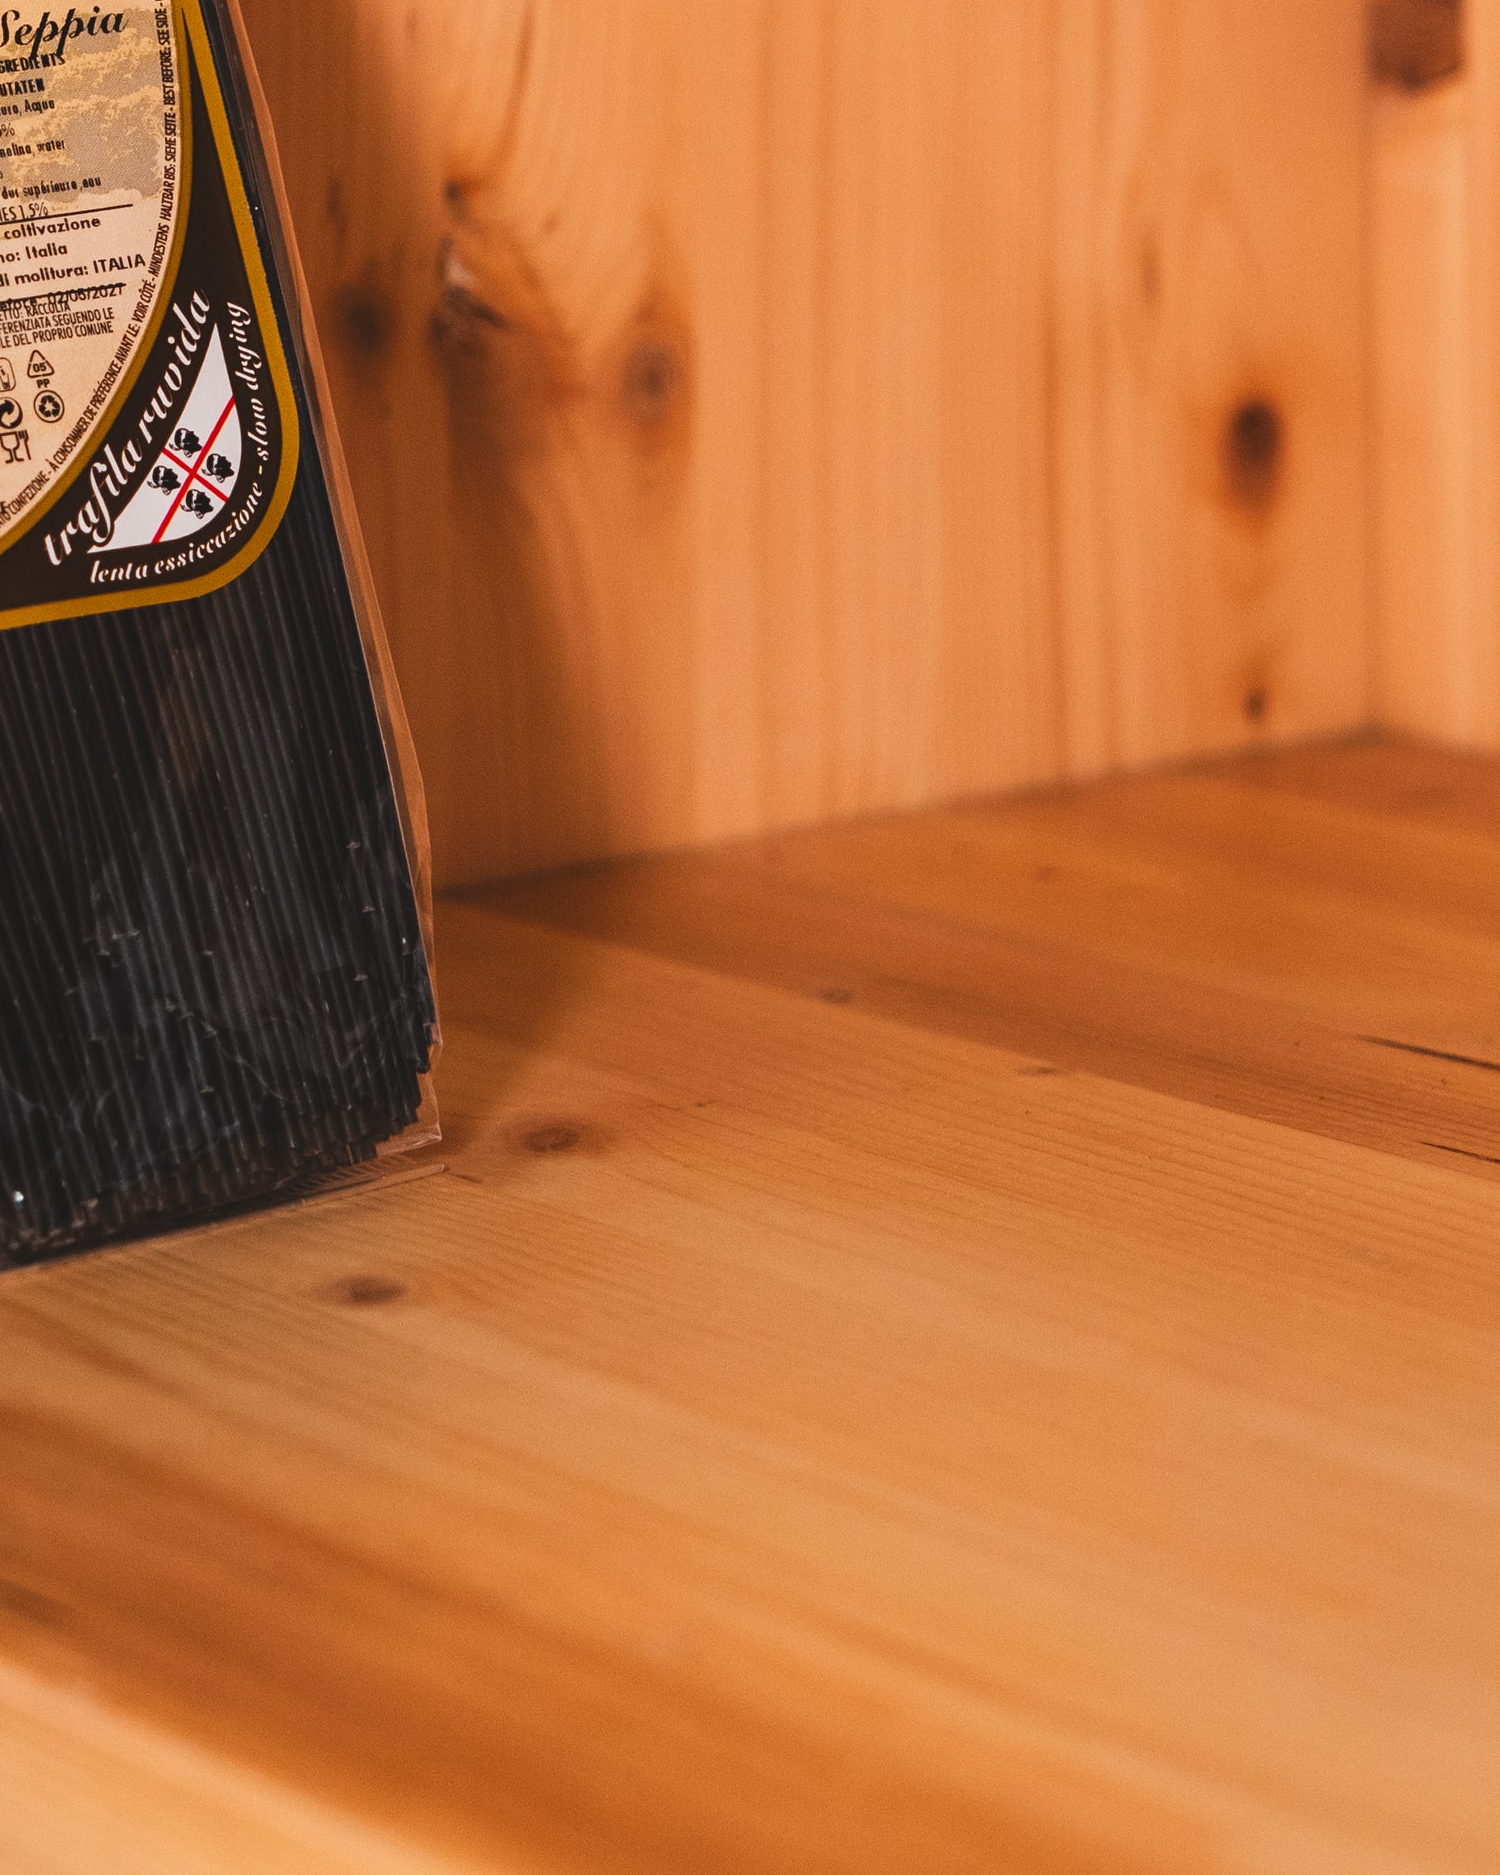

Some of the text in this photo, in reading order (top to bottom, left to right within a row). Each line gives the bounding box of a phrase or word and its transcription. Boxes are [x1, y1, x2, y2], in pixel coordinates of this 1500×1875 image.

[154, 8, 169, 28] SIDE
[157, 29, 171, 46] SEE
[159, 47, 174, 83] BEFORE:
[162, 83, 176, 105] BEST
[25, 99, 55, 115] Acqua
[164, 112, 177, 136] SEITE
[164, 137, 176, 163] SIEHE
[163, 163, 176, 181] BIS:
[1, 185, 19, 199] dur
[22, 180, 78, 198] supérieure
[159, 181, 175, 221] HALTBAR
[3, 217, 101, 240] coltivazione
[25, 243, 68, 259] Italia
[148, 222, 170, 277] MINDESTENS
[14, 265, 89, 285] molitura:
[92, 253, 146, 274] ITALIA
[138, 279, 156, 303] CÔTÉ
[26, 300, 71, 316] RACCOLTA
[52, 309, 102, 326] SEGUENDO
[103, 307, 115, 320] LE
[131, 301, 150, 324] VOIR
[13, 332, 31, 346] DEL
[33, 326, 73, 343] PROPRIO
[74, 321, 114, 338] COMUNE
[127, 323, 141, 338] LE:
[115, 334, 136, 365] AVANT
[32, 362, 47, 372] 05
[35, 379, 50, 389] PP
[89, 360, 124, 410] PRÉFÉRENCE
[83, 405, 98, 421] DE
[44, 289, 210, 566] trafila ruvida
[53, 417, 91, 468] CONSOMMER
[90, 300, 269, 584] lenta essiccazione slow drying
[7, 471, 50, 515] CONFEZIONE
